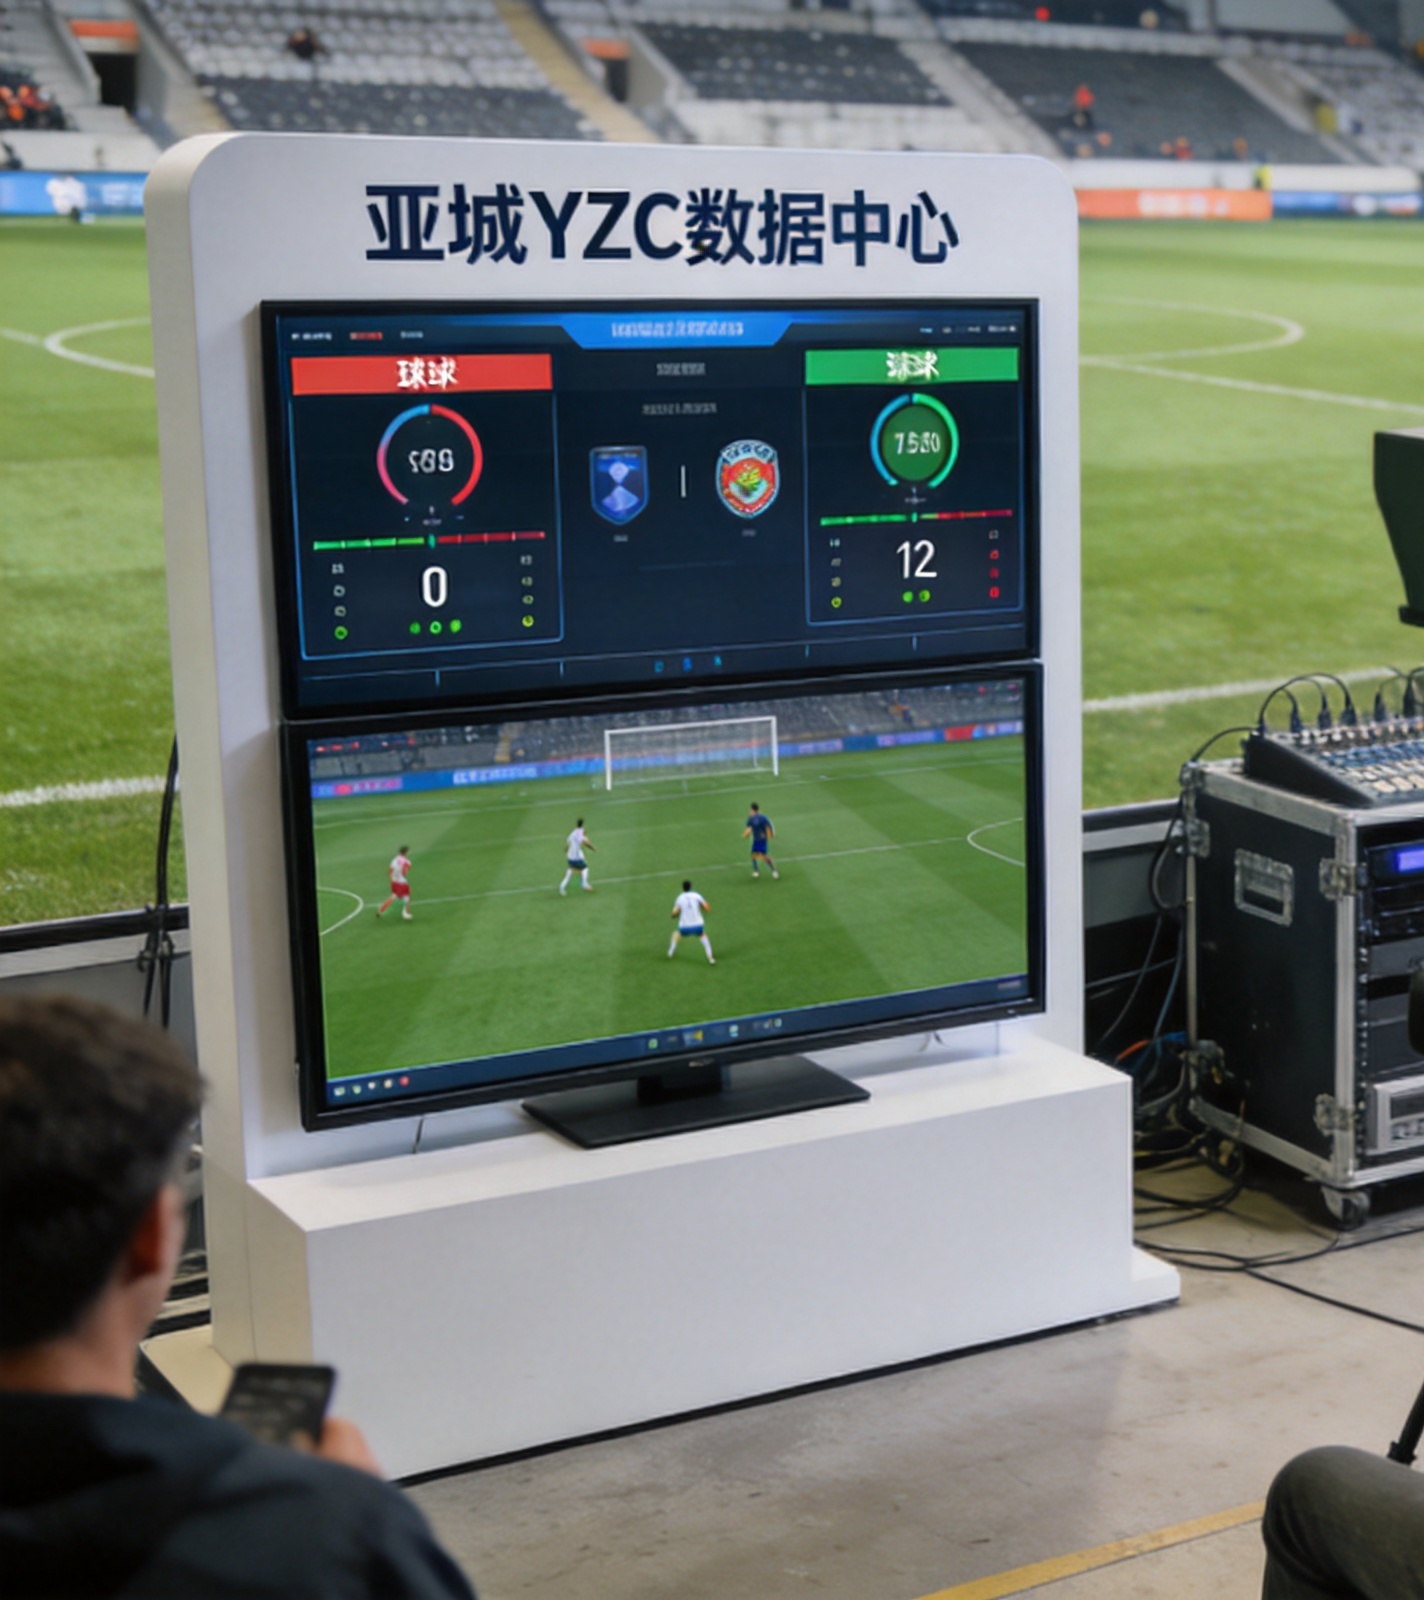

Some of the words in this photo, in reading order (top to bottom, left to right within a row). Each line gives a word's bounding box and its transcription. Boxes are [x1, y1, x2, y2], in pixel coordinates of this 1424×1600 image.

[366, 183, 960, 266] 亚城YZC数据中心
[896, 539, 938, 579] 12
[421, 565, 448, 608] 0
